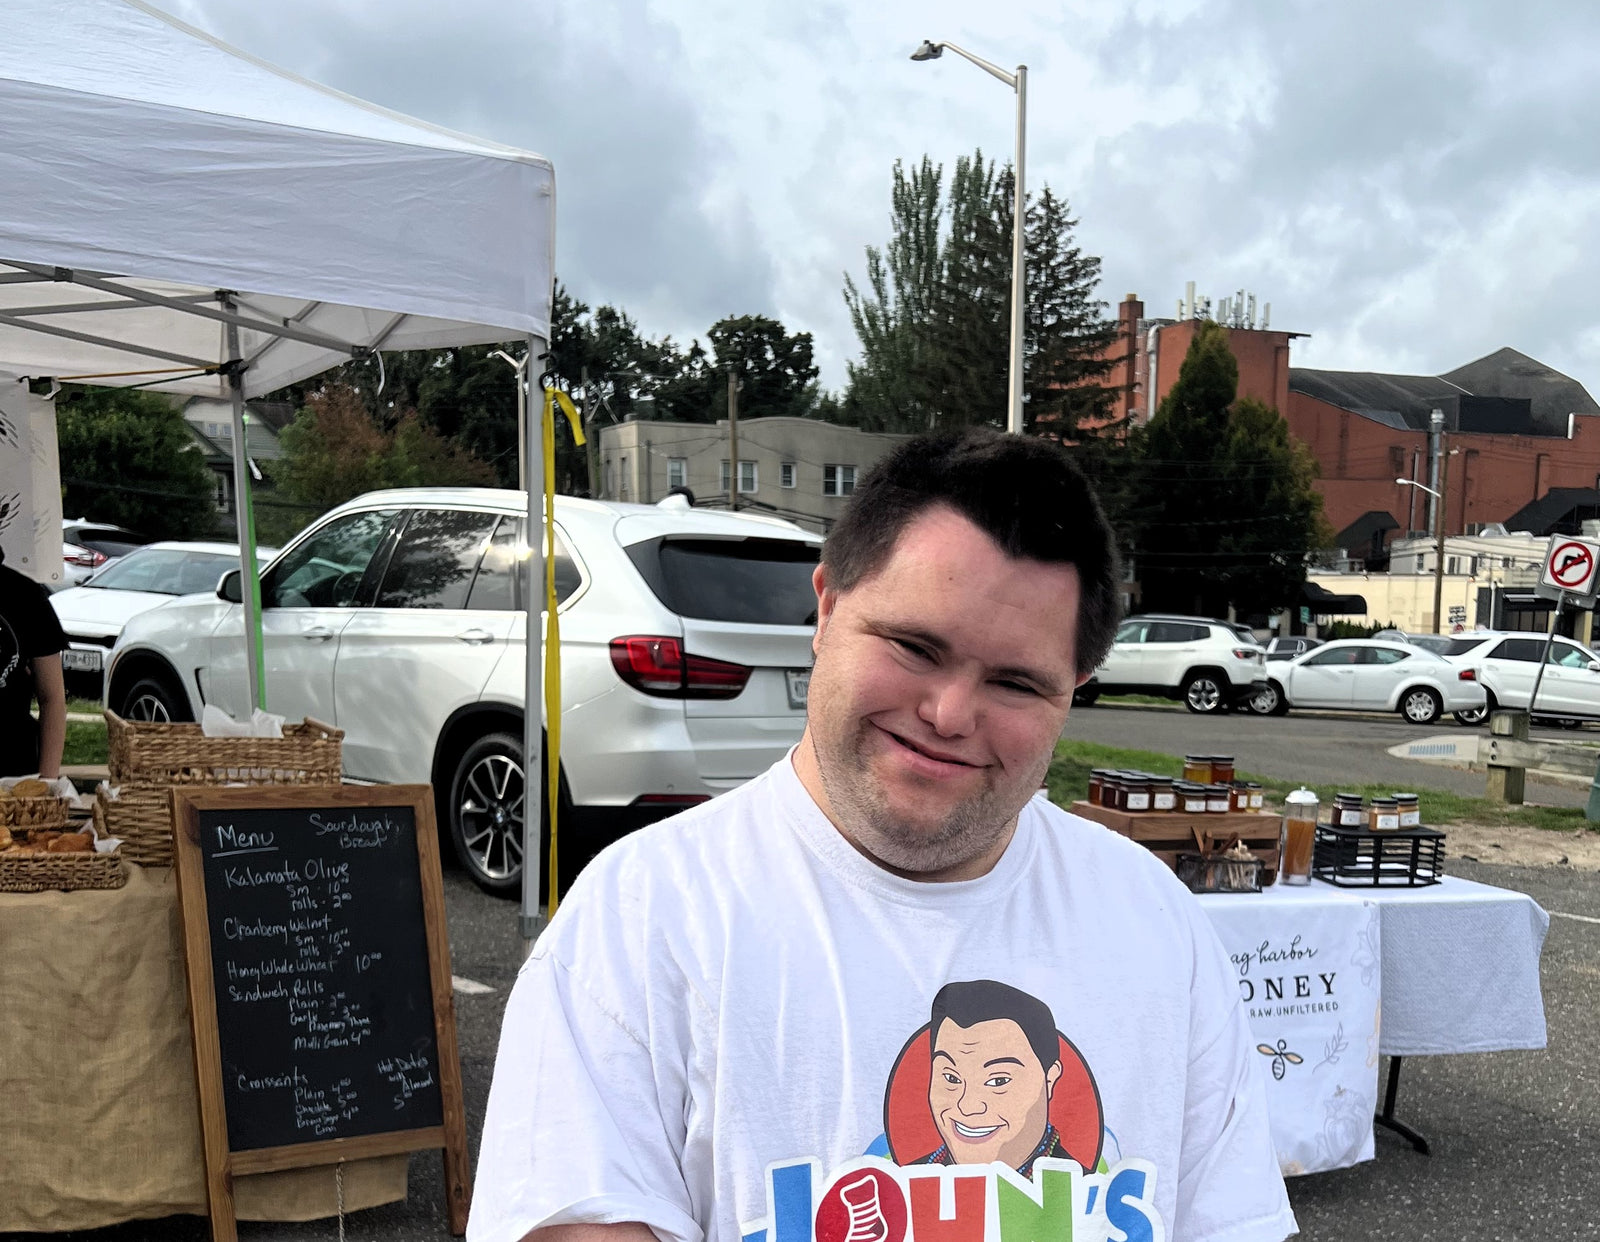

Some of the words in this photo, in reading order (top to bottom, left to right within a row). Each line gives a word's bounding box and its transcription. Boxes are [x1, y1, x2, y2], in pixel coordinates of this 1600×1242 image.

[216, 824, 275, 848] Menu
[224, 860, 302, 889] Kalamata
[305, 858, 349, 880] Olive
[1230, 952, 1257, 976] ag
[1256, 934, 1318, 965] harbor
[227, 960, 261, 981] Honey
[228, 980, 289, 1001] Sandwich
[293, 978, 324, 998] Rolls
[1239, 971, 1336, 1002] ONEY
[238, 1065, 309, 1092] Croissants
[742, 1162, 1155, 1242] JOHN'S
